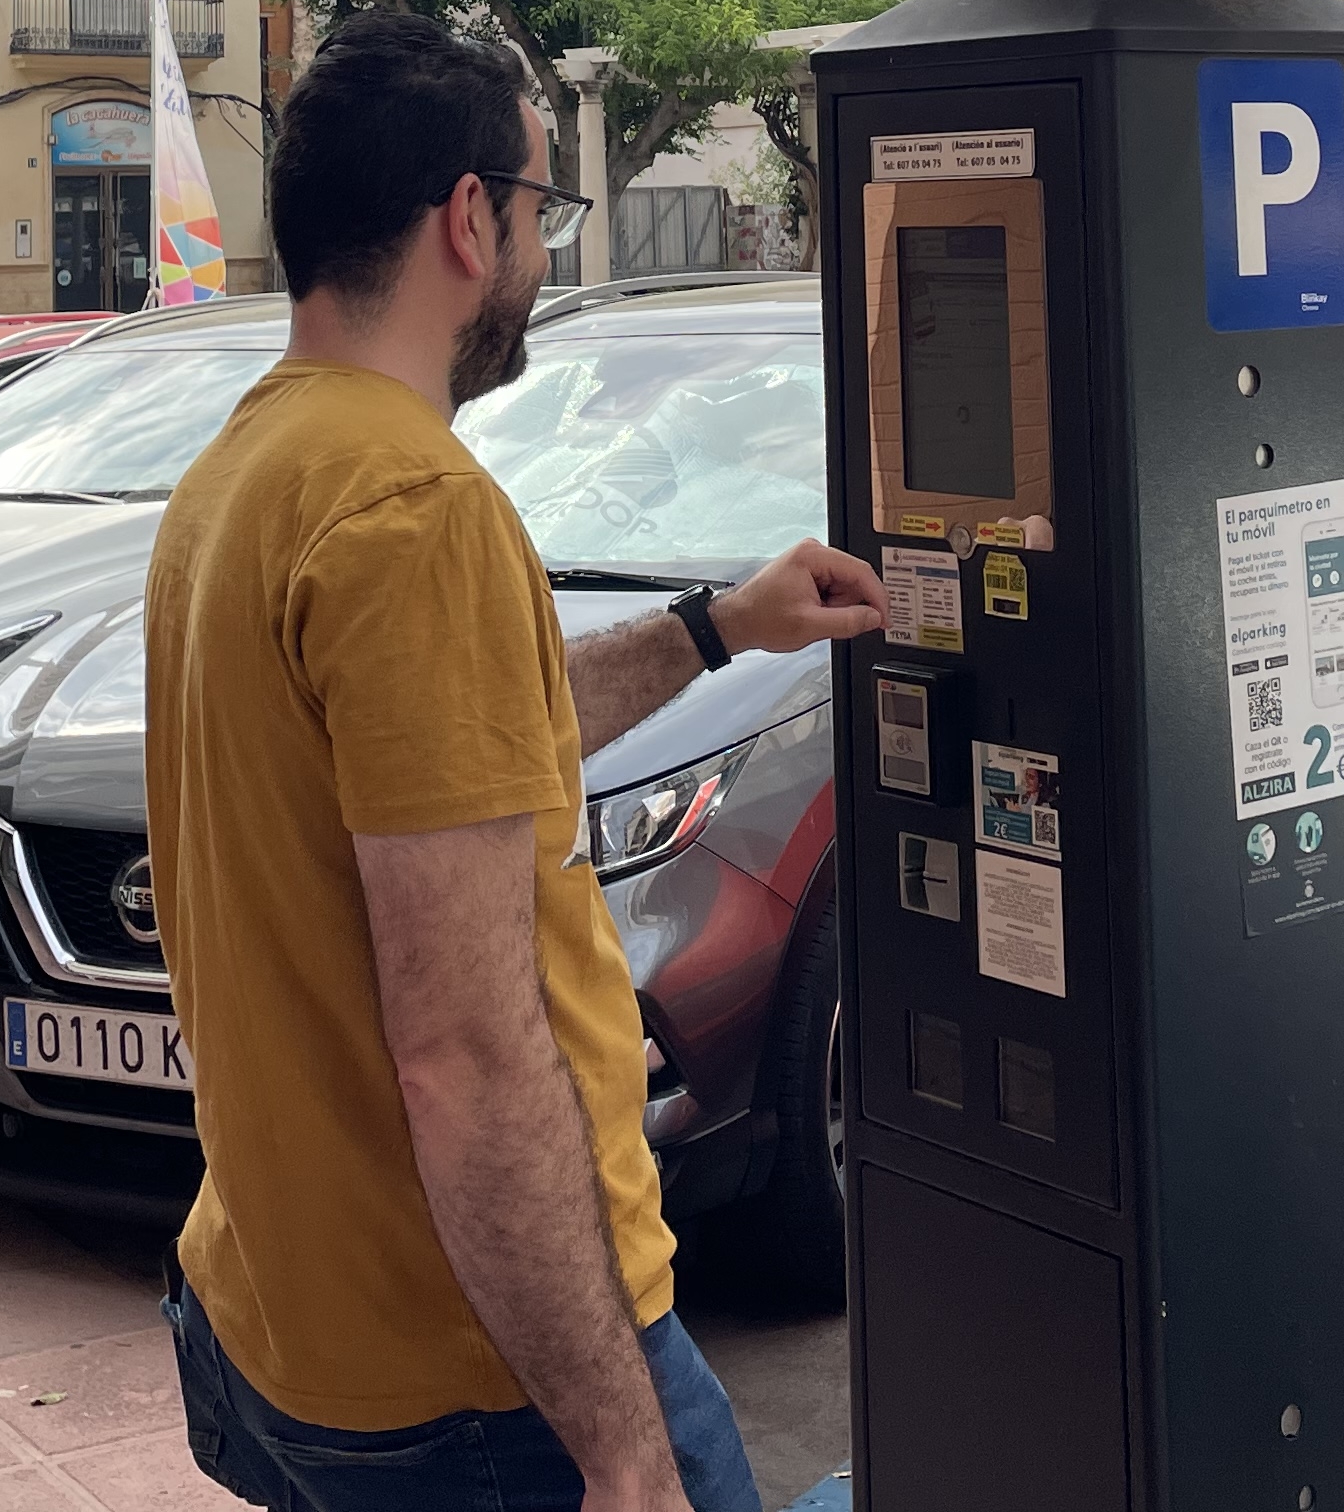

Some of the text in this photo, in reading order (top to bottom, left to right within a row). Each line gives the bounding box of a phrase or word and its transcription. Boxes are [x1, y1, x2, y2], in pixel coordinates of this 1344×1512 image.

[897, 160, 909, 170] 607
[911, 159, 920, 169] 05
[922, 159, 930, 168] 04
[933, 158, 942, 168] 75
[971, 156, 984, 167] 607
[986, 156, 996, 166] 05
[999, 155, 1009, 165] 04
[1011, 155, 1021, 165] 75
[1231, 102, 1320, 276] P
[1225, 497, 1331, 526] El parquímetro en
[1226, 522, 1276, 544] tu móvil
[1231, 621, 1286, 646] elparking
[1270, 736, 1282, 746] QR
[1243, 776, 1294, 802] ALZIRA
[37, 1012, 144, 1074] 0110
